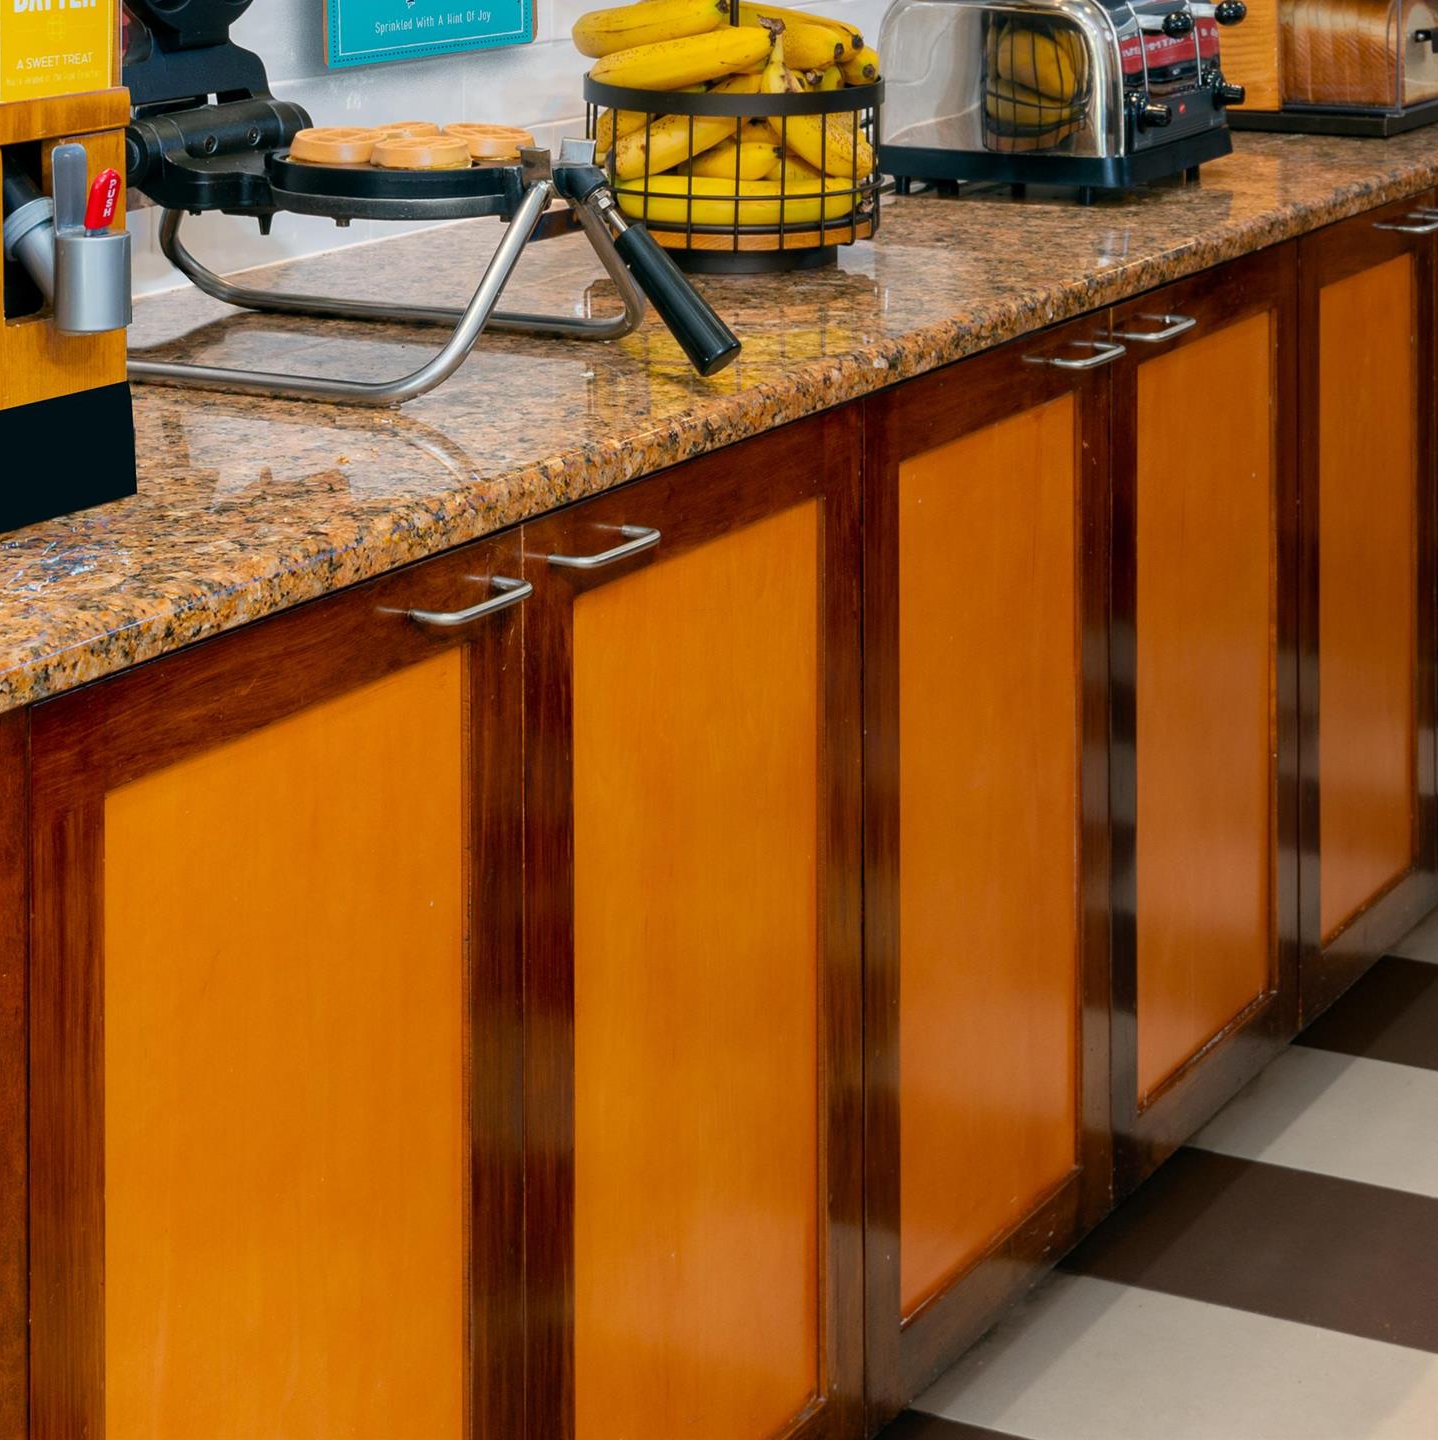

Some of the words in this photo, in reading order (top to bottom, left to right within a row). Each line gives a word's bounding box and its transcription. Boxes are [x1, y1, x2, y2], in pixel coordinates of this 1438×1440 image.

[375, 18, 413, 36] Sprinkled
[416, 15, 435, 28] With
[438, 14, 444, 26] A
[447, 13, 463, 25] Hint
[466, 10, 475, 23] Of
[477, 9, 491, 23] Joy
[16, 59, 24, 70] A
[25, 54, 60, 69] SWEET
[63, 51, 94, 65] TREAT
[103, 178, 117, 218] PUSH
